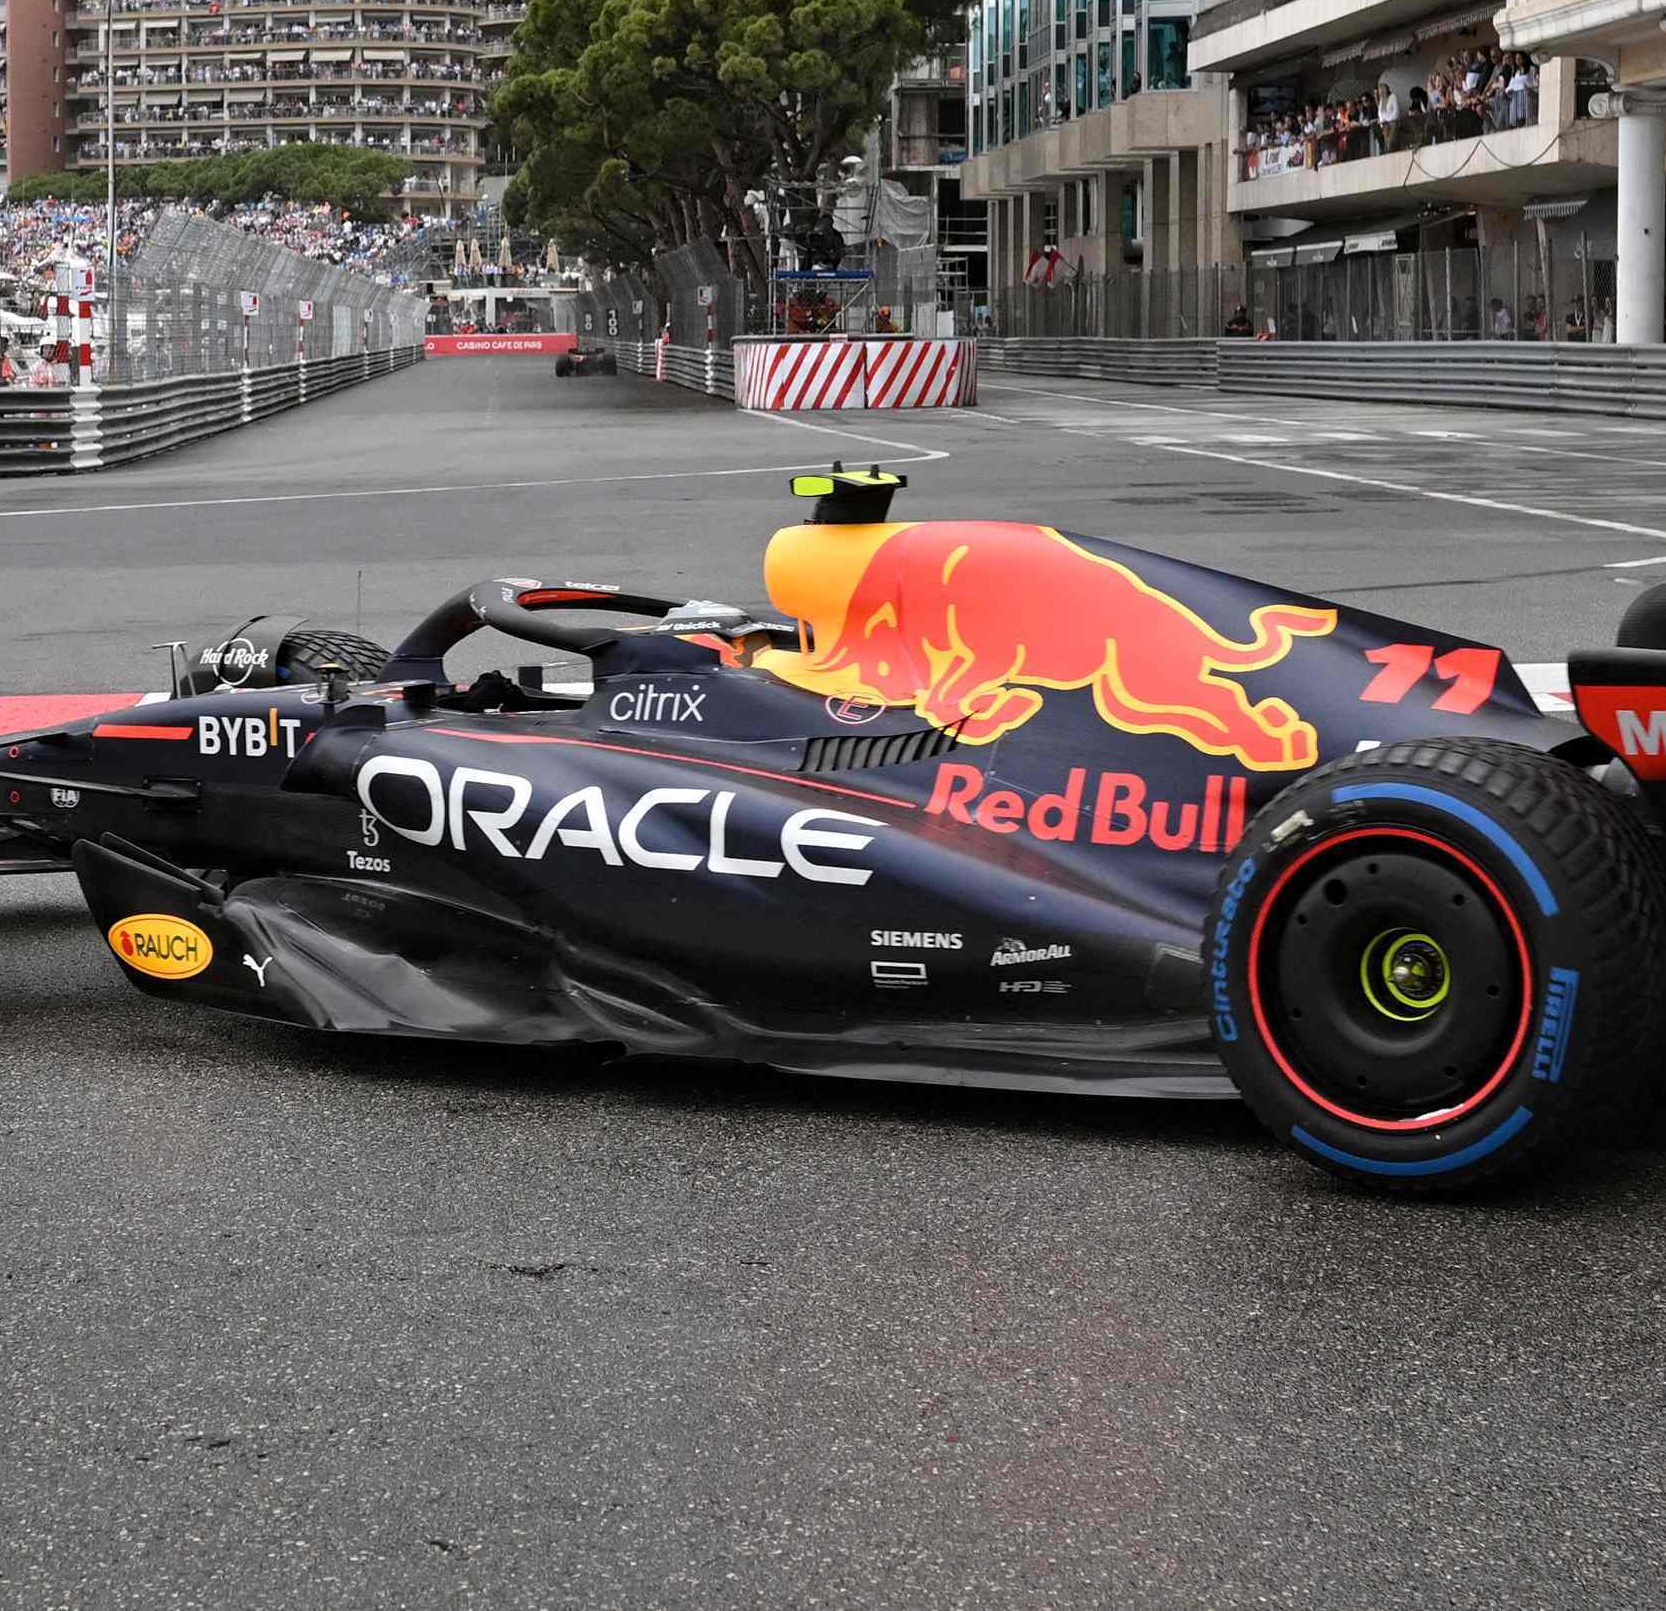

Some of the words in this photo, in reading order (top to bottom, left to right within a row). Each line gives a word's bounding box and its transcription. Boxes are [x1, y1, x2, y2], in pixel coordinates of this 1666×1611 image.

[608, 309, 618, 336] 100
[456, 341, 490, 350] CASINO
[200, 648, 234, 665] Hard
[233, 647, 269, 668] Rock
[1358, 642, 1502, 715] 11
[609, 684, 707, 723] citrix
[199, 707, 302, 759] BYBIT
[357, 755, 889, 885] ORACLE
[924, 763, 1088, 842] Red
[1091, 772, 1247, 853] Bull
[347, 851, 391, 873] Tezos
[134, 935, 199, 964] RAUCH
[870, 929, 963, 949] SIEMENS
